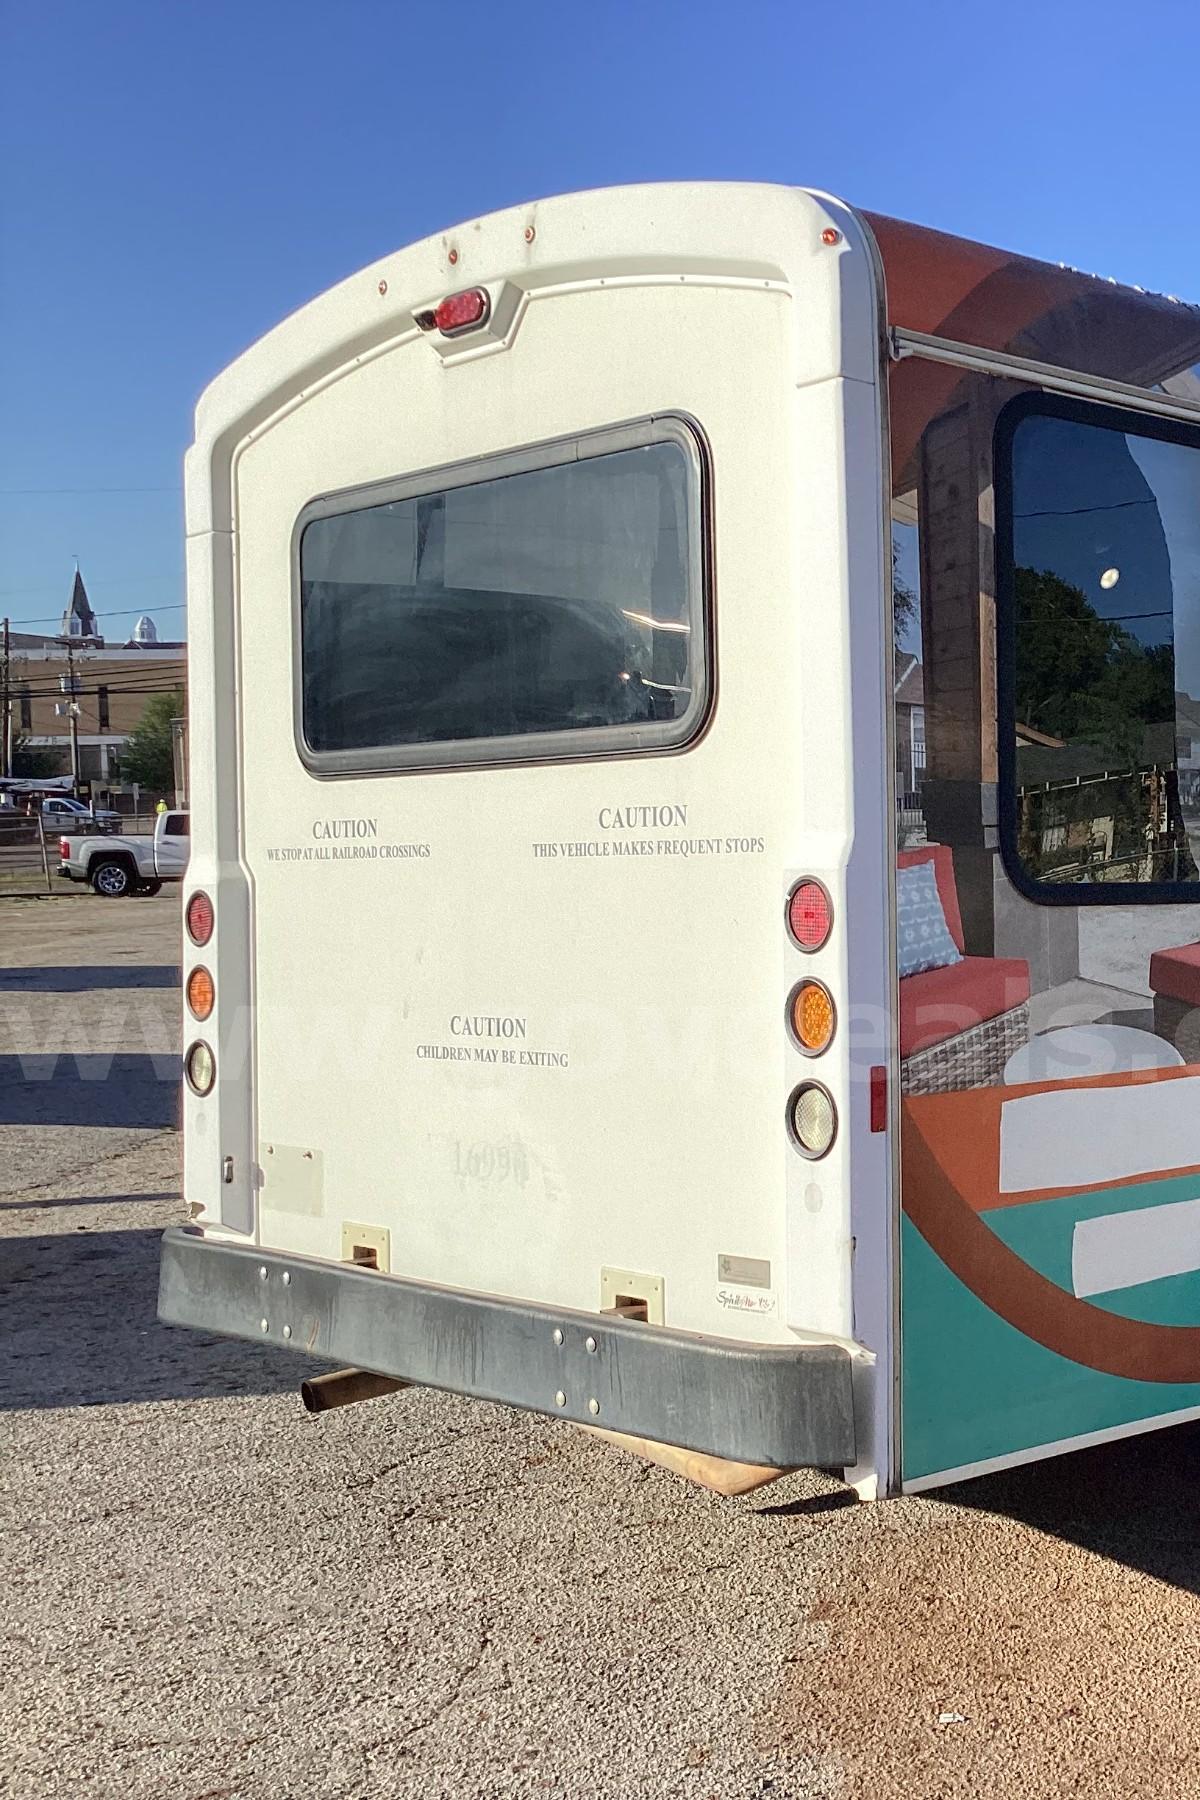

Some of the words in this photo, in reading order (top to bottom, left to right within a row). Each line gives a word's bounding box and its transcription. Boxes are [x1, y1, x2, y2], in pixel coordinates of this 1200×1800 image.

[598, 804, 688, 830] CAUTION
[312, 818, 378, 840] CAUTION
[267, 847, 281, 861] WE
[282, 847, 302, 861] STOP
[302, 847, 314, 860] AT
[314, 847, 331, 860] ALL
[332, 846, 377, 860] RAILROAD
[379, 844, 431, 859] CROSSINGS
[532, 843, 557, 858] THIS
[559, 841, 610, 857] VEHICLE
[612, 840, 654, 856] MAKES
[656, 838, 723, 858] FREQUENT
[725, 837, 765, 854] STOPS
[450, 1015, 527, 1039] CAUTION
[416, 1044, 473, 1062] CHILDREN
[473, 1048, 500, 1064] MAY
[501, 1050, 517, 1065] BE
[519, 1050, 569, 1068] EXITING
